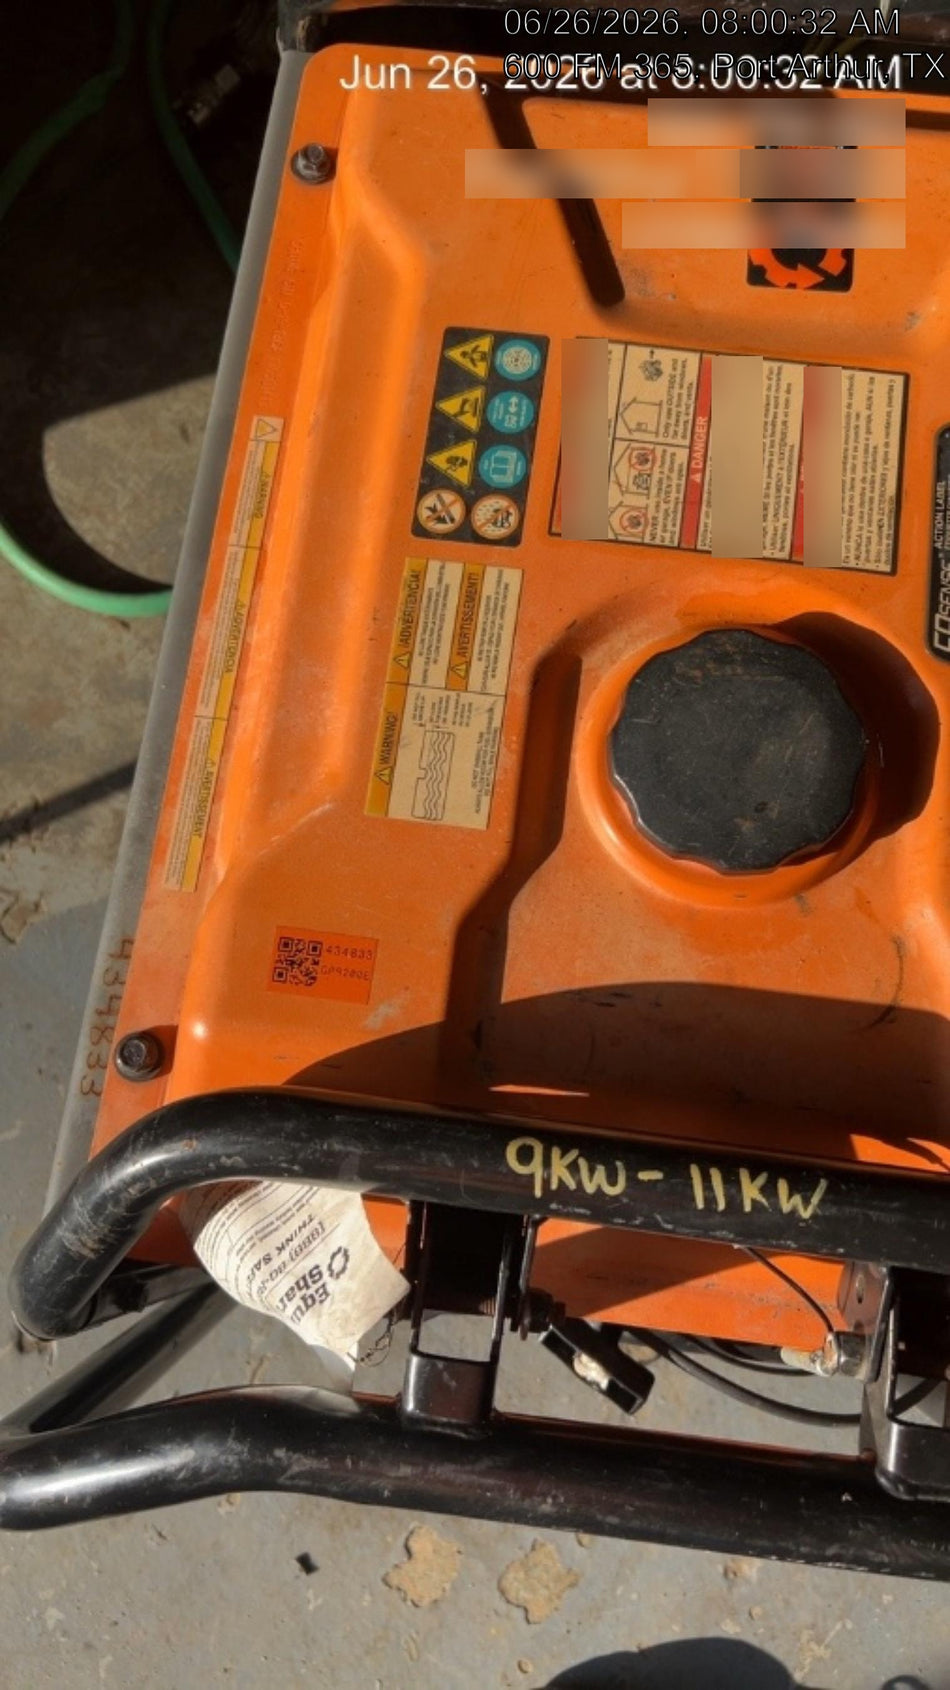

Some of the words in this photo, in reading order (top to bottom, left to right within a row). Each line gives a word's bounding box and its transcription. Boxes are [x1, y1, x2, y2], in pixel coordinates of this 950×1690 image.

[691, 416, 708, 468] DANGER
[935, 507, 948, 550] ACTION
[380, 711, 397, 765] WARNING!
[80, 938, 134, 1096] 434833
[275, 1214, 313, 1256] THINK
